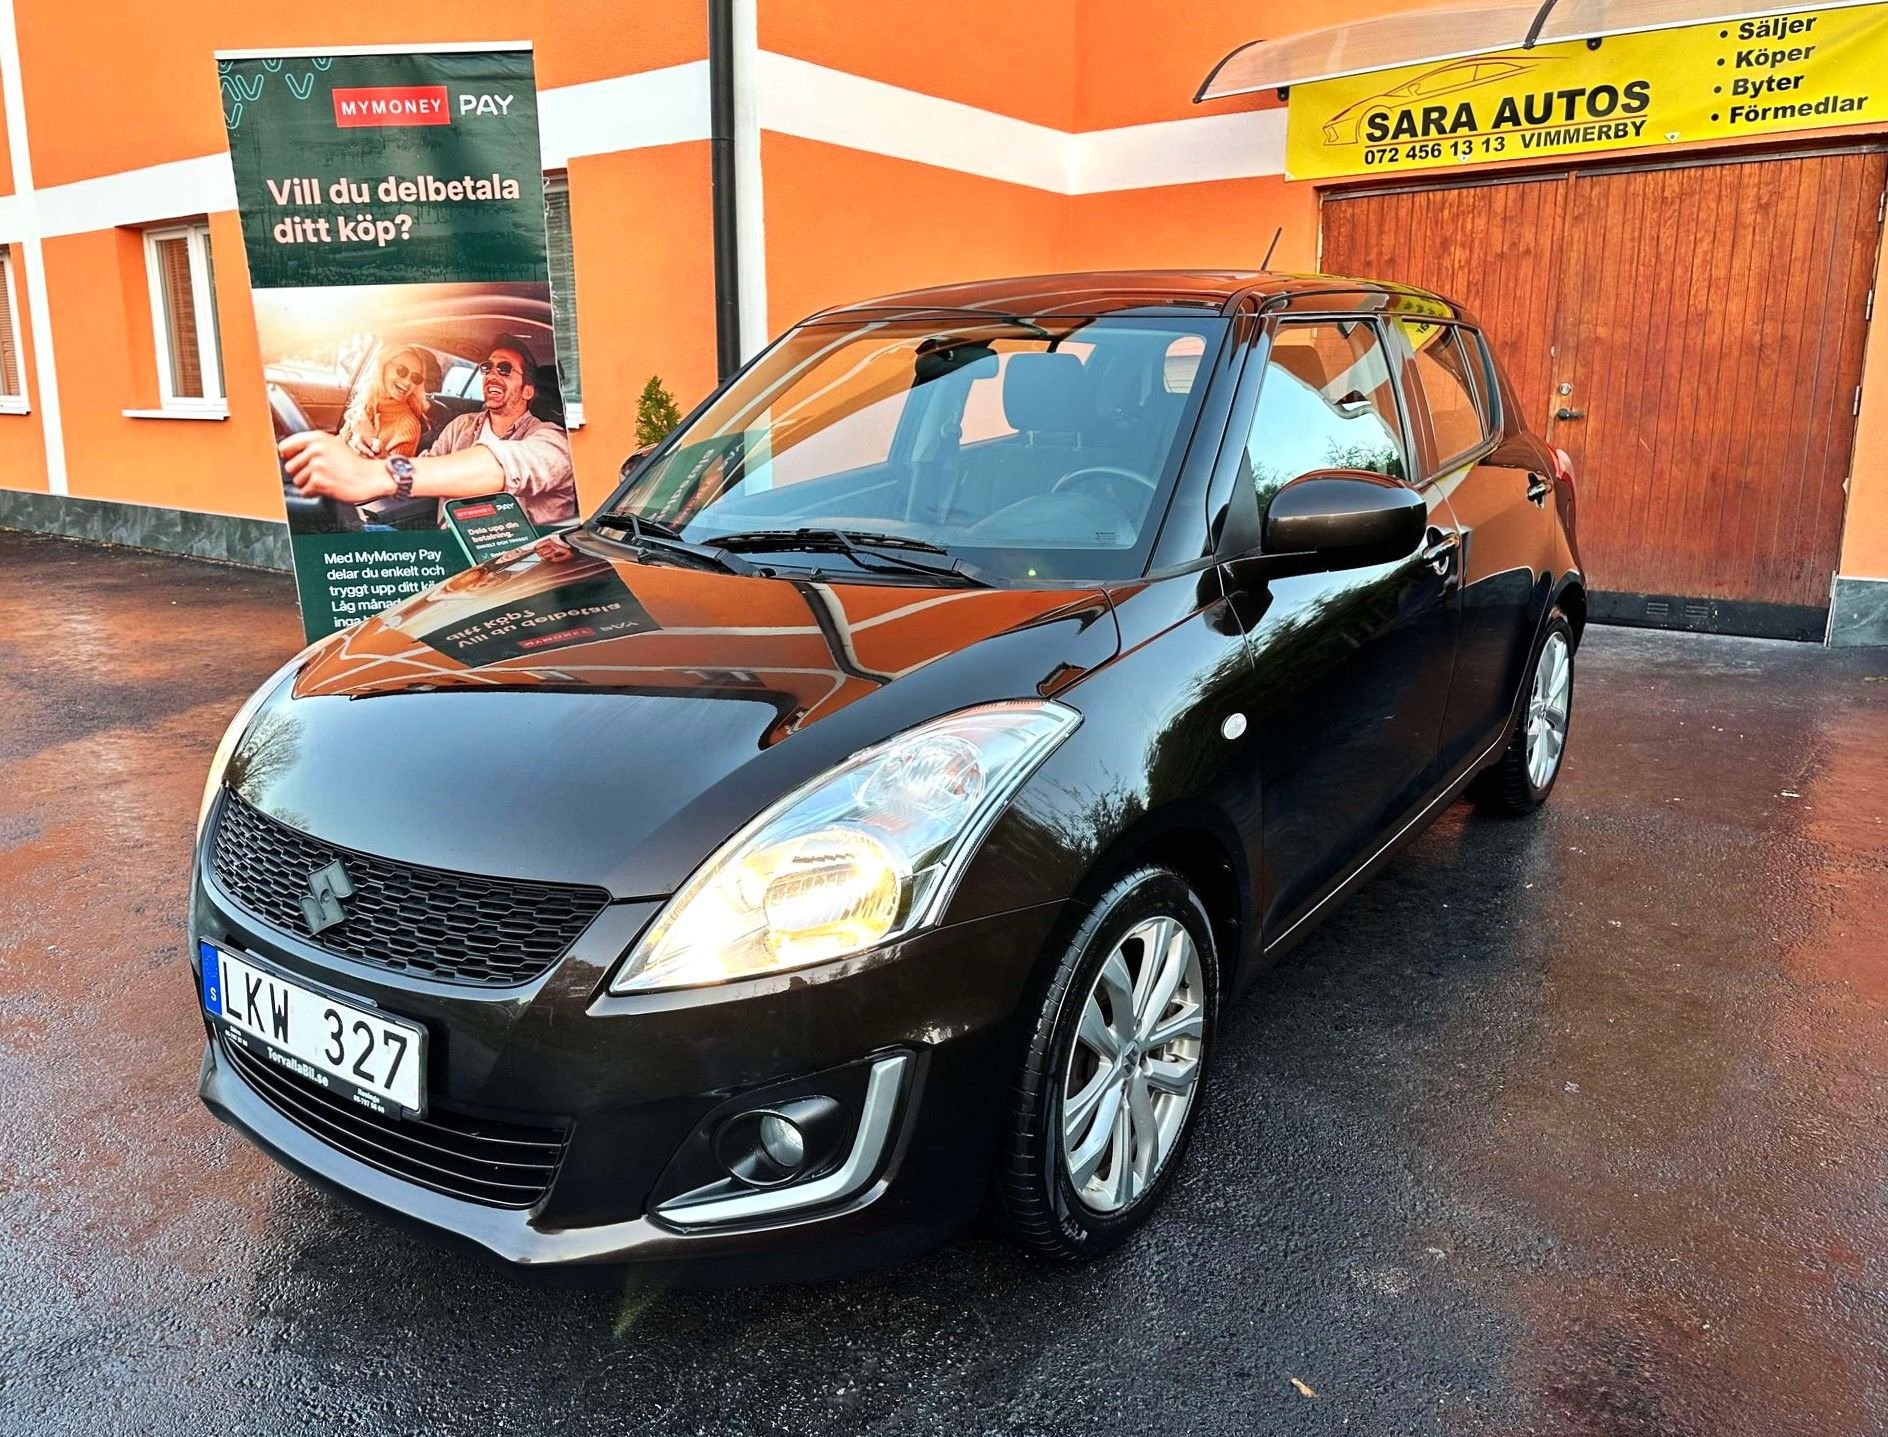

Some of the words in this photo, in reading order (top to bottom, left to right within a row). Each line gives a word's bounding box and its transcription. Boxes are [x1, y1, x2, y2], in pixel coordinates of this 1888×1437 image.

[1738, 16, 1817, 41] Säljer
[1735, 45, 1816, 68] Köper
[1732, 75, 1805, 99] Byter
[341, 98, 441, 116] MYMONEY
[459, 94, 514, 116] PAY
[1365, 102, 1478, 143] SARA
[1491, 80, 1650, 129] AUTOS
[1730, 96, 1869, 124] Förmedlar
[1364, 147, 1399, 165] 072
[1405, 142, 1442, 160] 456
[1450, 139, 1473, 157] 13
[1481, 136, 1505, 153] 13
[1520, 119, 1647, 148] VIMMERBY
[266, 178, 322, 206] Vill
[329, 176, 370, 204] du
[378, 174, 520, 203] delbetala
[273, 216, 332, 244] ditt
[338, 213, 412, 247] köp?
[496, 503, 514, 511] PAY
[472, 531, 514, 542] betalning.
[488, 524, 505, 533] upp
[324, 552, 353, 565] Med
[355, 550, 416, 564] MyMoney
[419, 549, 442, 562] Pay
[327, 568, 359, 580] delar
[361, 567, 378, 579] du
[381, 565, 419, 578] enkelt
[421, 564, 445, 576] och
[329, 583, 369, 598] tryggt
[371, 585, 396, 596] upp
[398, 581, 419, 593] ditt
[420, 580, 437, 592] kö
[331, 600, 356, 614] Låg
[358, 598, 402, 611] månad
[210, 987, 217, 1002] S
[222, 960, 289, 1044] LKW
[323, 1008, 408, 1090] 327
[267, 1046, 329, 1087] TorvallaBil.se
